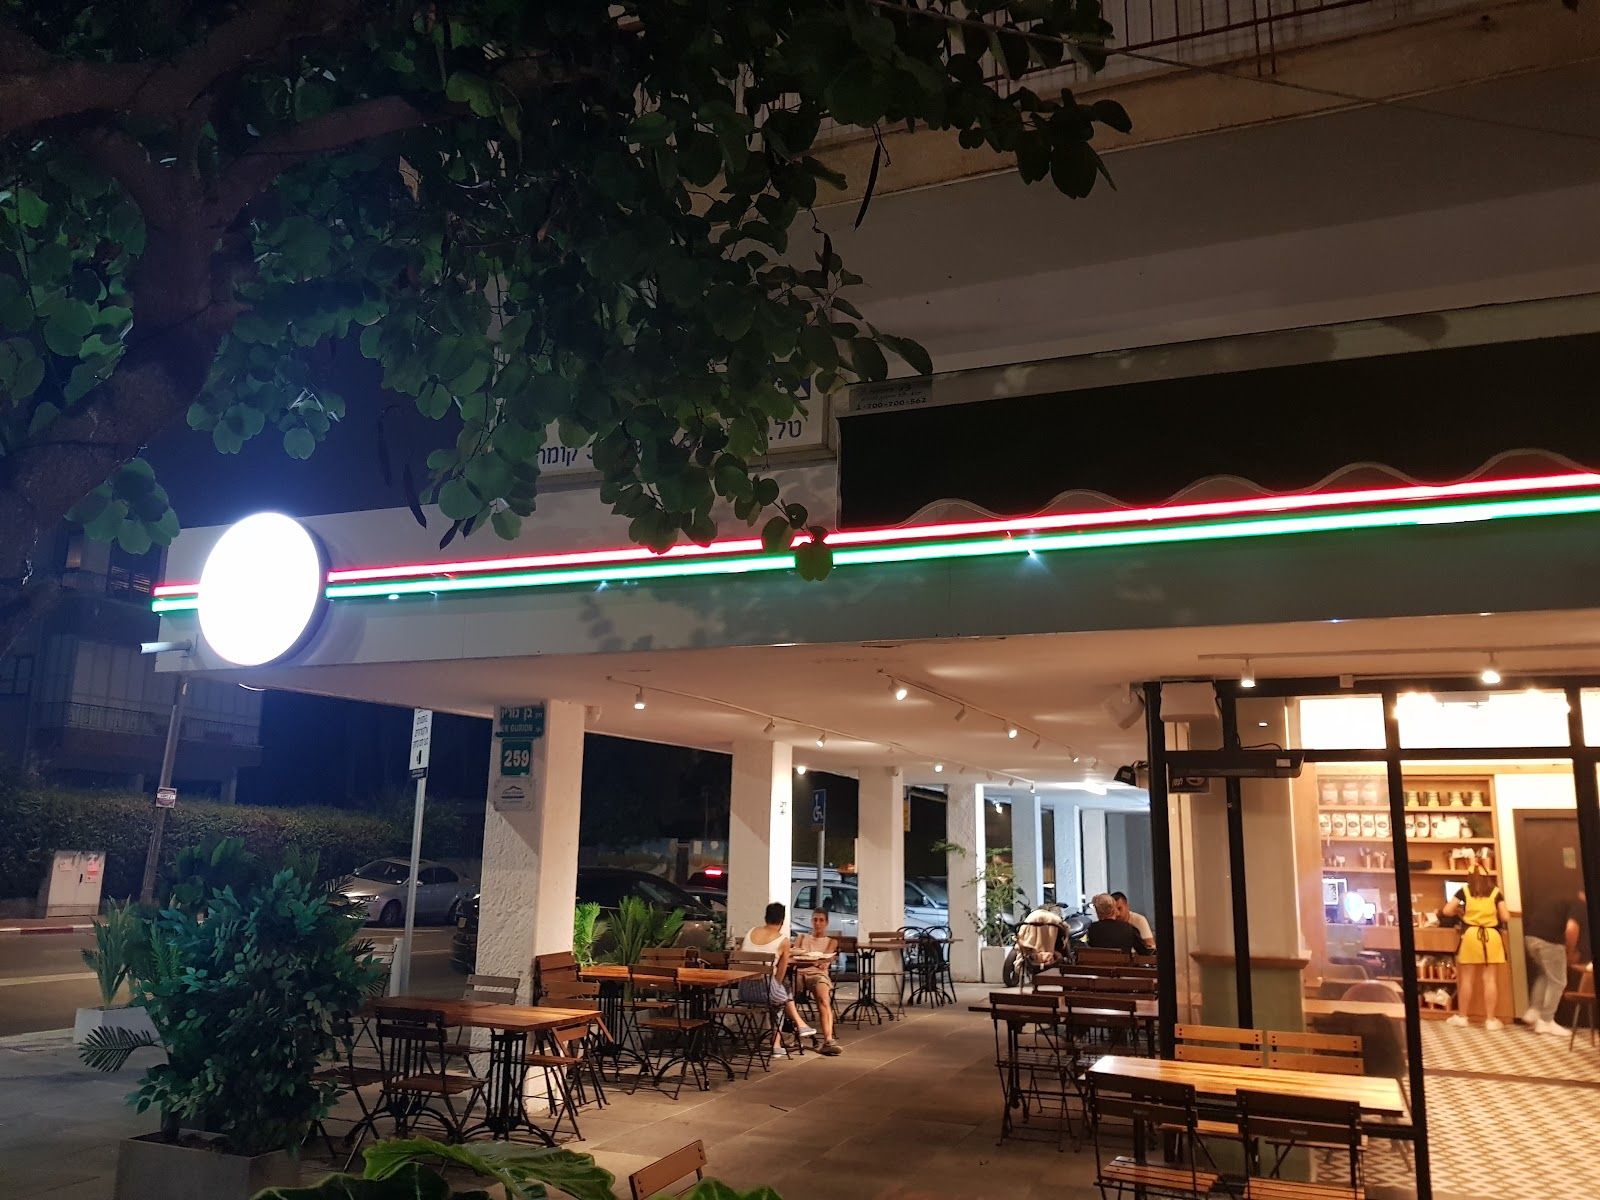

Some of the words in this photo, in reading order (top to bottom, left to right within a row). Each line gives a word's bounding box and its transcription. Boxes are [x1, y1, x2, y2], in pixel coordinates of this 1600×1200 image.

[523, 708, 532, 722] בן
[510, 723, 533, 732] GURION
[504, 750, 530, 767] 259
